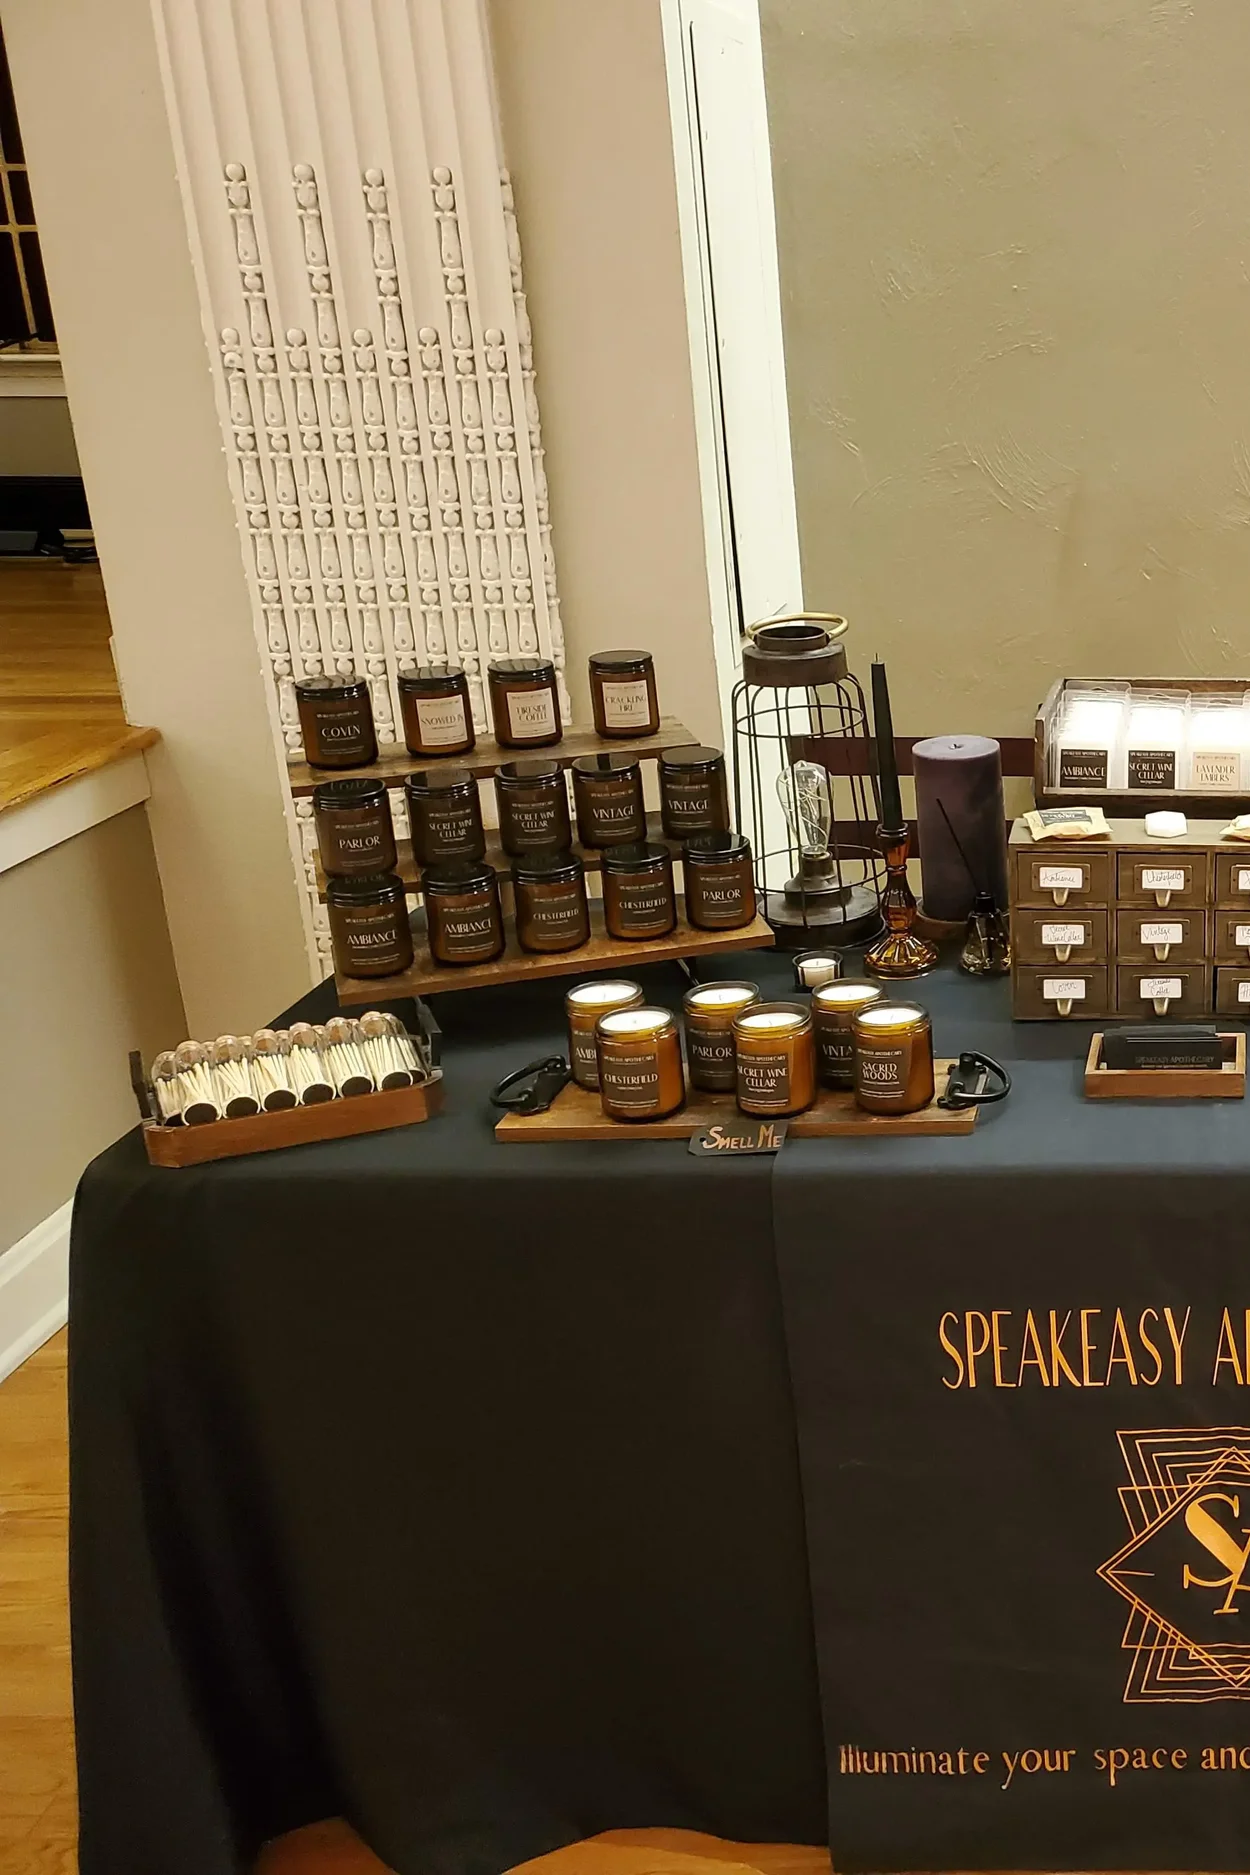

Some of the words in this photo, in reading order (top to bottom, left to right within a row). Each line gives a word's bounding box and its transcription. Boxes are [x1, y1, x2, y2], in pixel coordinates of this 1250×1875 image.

[321, 724, 361, 739] COVEN
[1061, 766, 1105, 777] AMBIANCE
[1129, 763, 1155, 771] SECRET
[1156, 763, 1173, 772] WINE
[1196, 765, 1236, 774] LAVENDER
[1137, 771, 1165, 780] CELLAR
[1200, 773, 1230, 782] EMBERS
[669, 799, 709, 812] VINTAGE
[512, 812, 539, 822] SECRET
[540, 810, 555, 820] WINE
[593, 806, 635, 819] VINTAGE
[429, 821, 457, 831] SECRET
[458, 819, 473, 829] WINE
[521, 820, 549, 829] CELLAR
[439, 828, 467, 838] CELLAR
[339, 836, 381, 849] PARLOR
[703, 889, 742, 901] PARLOR
[619, 897, 667, 910] CHESTERFIELD
[533, 908, 579, 921] CHESTERFIELD
[445, 919, 492, 934] AMBIANCE
[346, 930, 397, 945] AMBIANCE
[692, 1044, 734, 1058] PARLOR
[737, 1065, 764, 1078] SECRET
[766, 1067, 788, 1078] WINE
[862, 1061, 898, 1072] SACRED
[604, 1073, 659, 1085] CHESTERFIELD
[862, 1070, 898, 1081] WOODS
[746, 1078, 777, 1088] CELLAR
[938, 1304, 1191, 1388] SPEAKEASY
[839, 1742, 990, 1776] Illuminate
[1001, 1747, 1076, 1790] your
[1094, 1745, 1188, 1787] space
